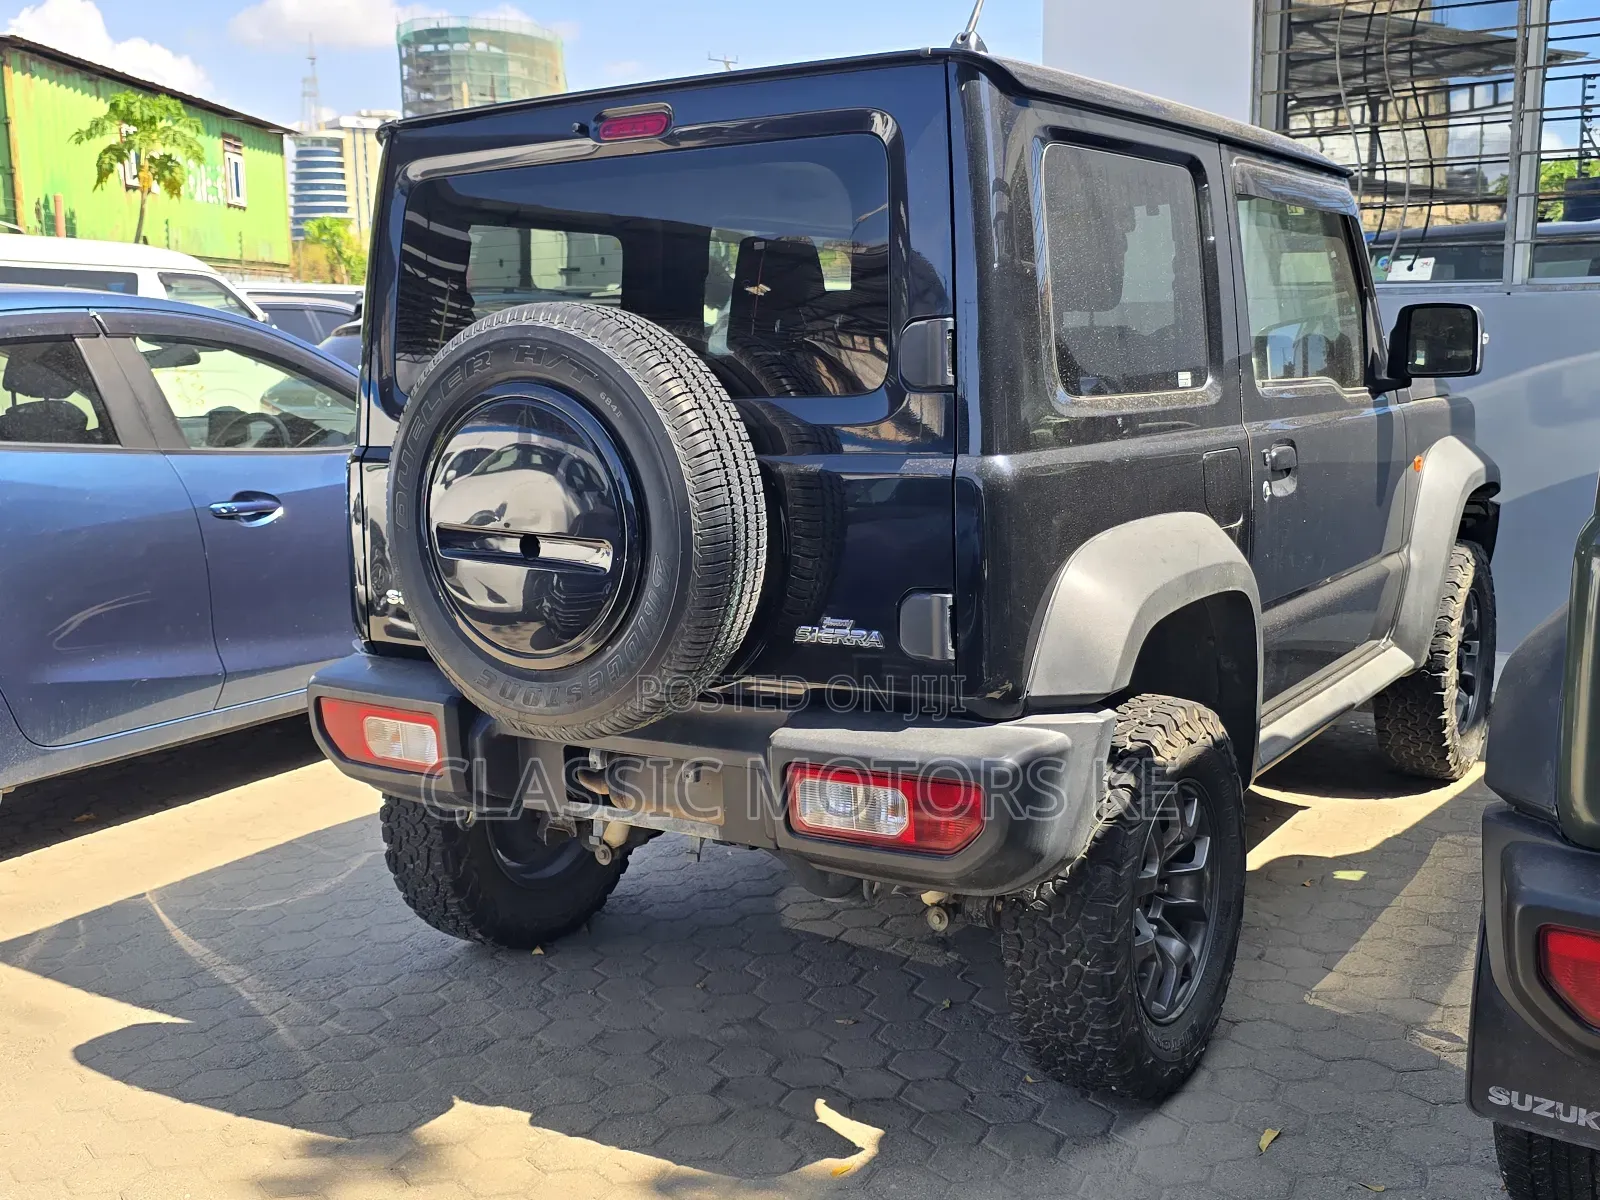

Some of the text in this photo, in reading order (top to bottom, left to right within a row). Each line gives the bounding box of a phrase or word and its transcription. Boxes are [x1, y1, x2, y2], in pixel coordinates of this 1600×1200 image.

[396, 350, 494, 532] DUELER
[510, 344, 599, 384] H/T
[474, 552, 673, 708] BRIDGESTONE
[794, 625, 884, 648] SIERRA
